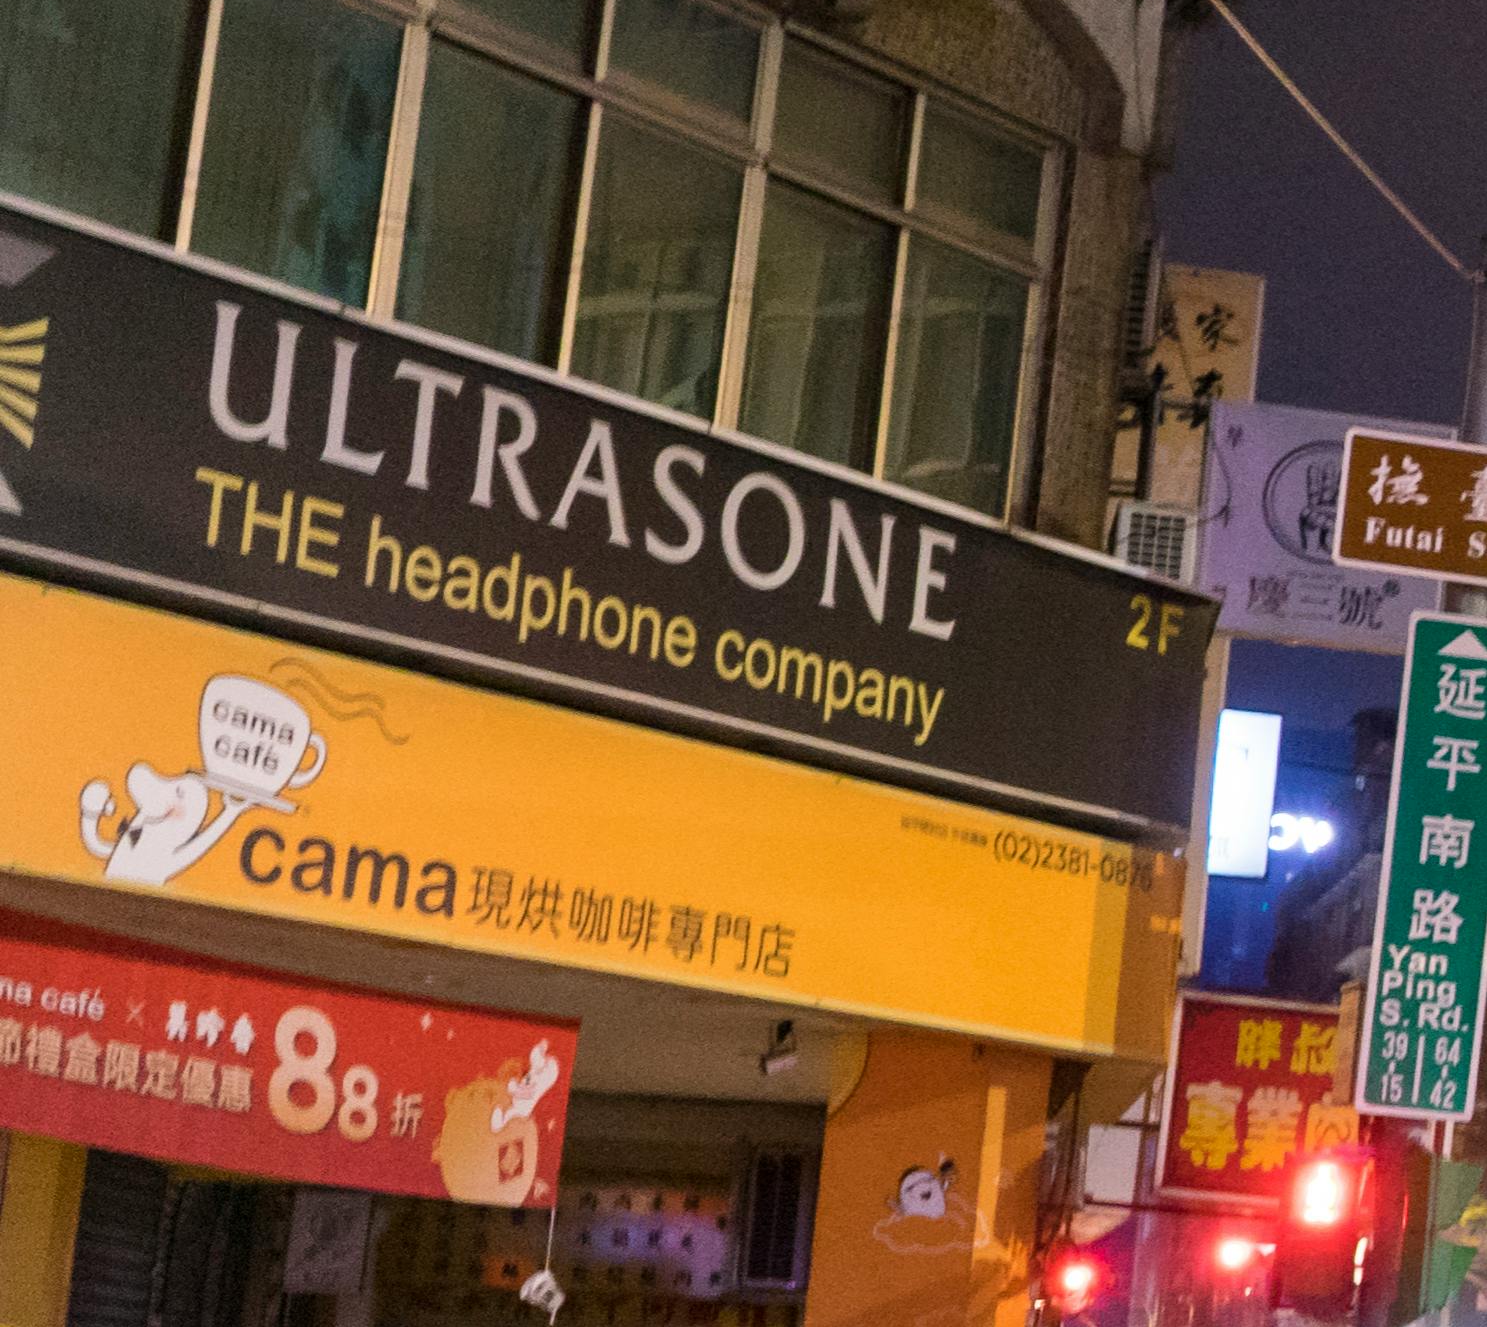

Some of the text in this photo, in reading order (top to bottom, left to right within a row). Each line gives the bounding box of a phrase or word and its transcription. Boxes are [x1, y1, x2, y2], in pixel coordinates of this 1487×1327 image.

[207, 300, 957, 642] ULTRASONE
[1364, 515, 1445, 555] Futai
[194, 467, 946, 747] THE headphone company
[1126, 595, 1186, 657] 2F
[211, 694, 296, 748] cama
[212, 731, 282, 777] café
[239, 823, 797, 979] cama 現烘咖啡專門店
[1388, 945, 1448, 976] Yan
[41, 984, 105, 1022] café
[1382, 973, 1457, 1007] Ping
[1380, 999, 1469, 1033] S. Rd.
[1382, 1032, 1461, 1063] 39 64
[1380, 1075, 1455, 1110] 15 42
